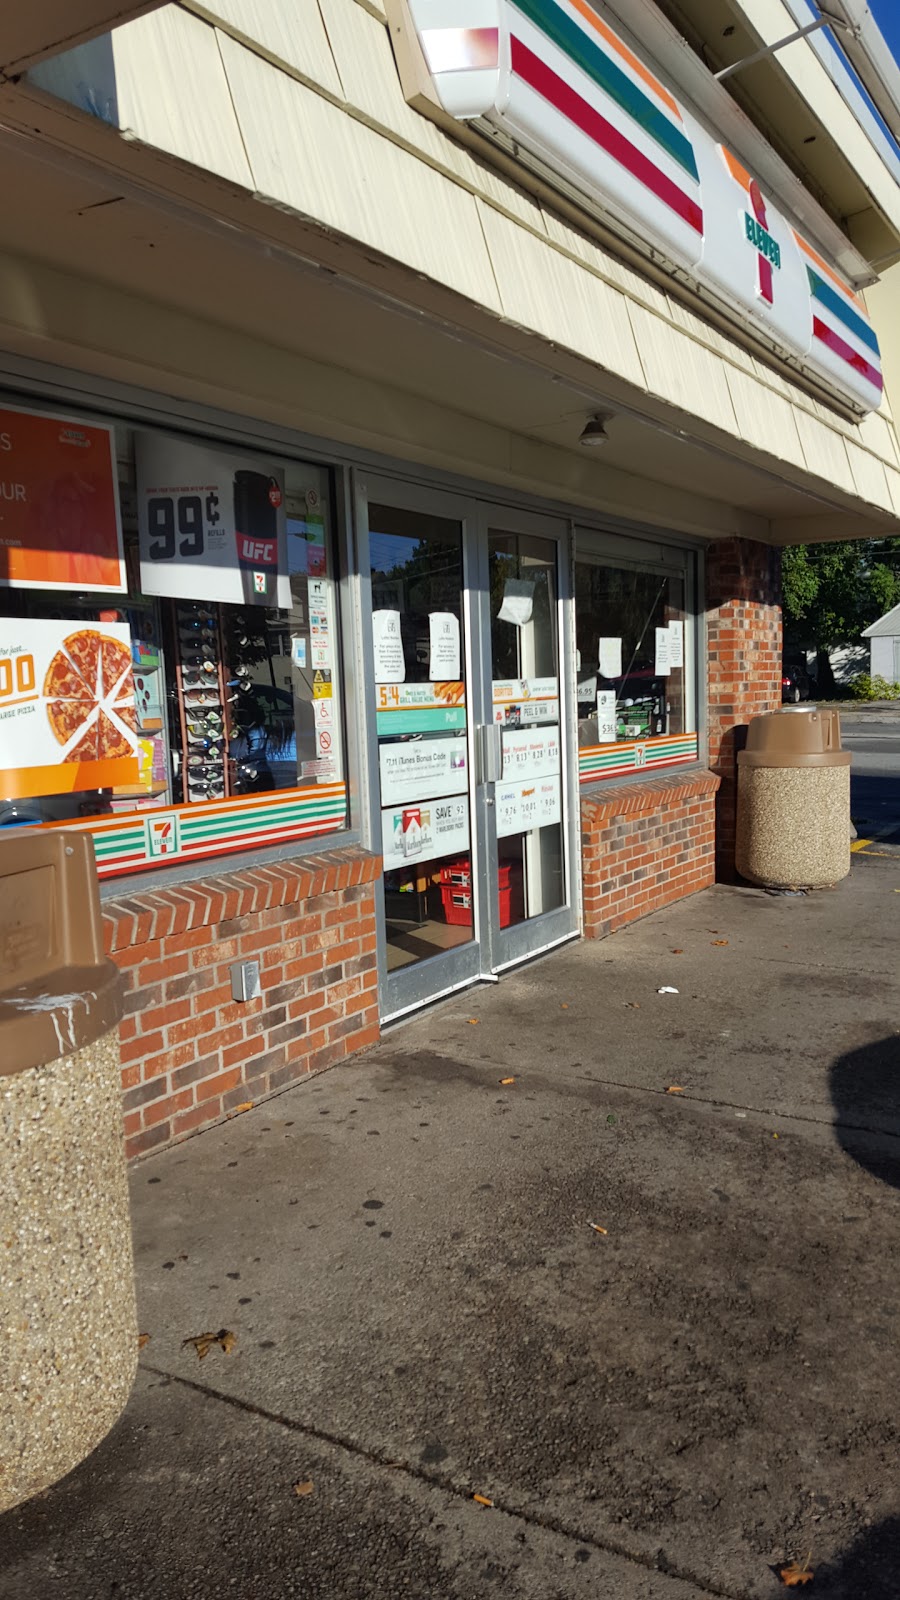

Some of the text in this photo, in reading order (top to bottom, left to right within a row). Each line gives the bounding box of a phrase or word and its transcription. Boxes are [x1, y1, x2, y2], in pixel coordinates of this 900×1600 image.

[744, 210, 782, 269] ELEVEN
[242, 539, 273, 561] UFC
[17, 704, 35, 715] PIZZA
[416, 754, 433, 763] Bonus
[433, 752, 446, 761] Code
[435, 805, 452, 820] SAVE
[154, 836, 173, 846] ELEVEN
